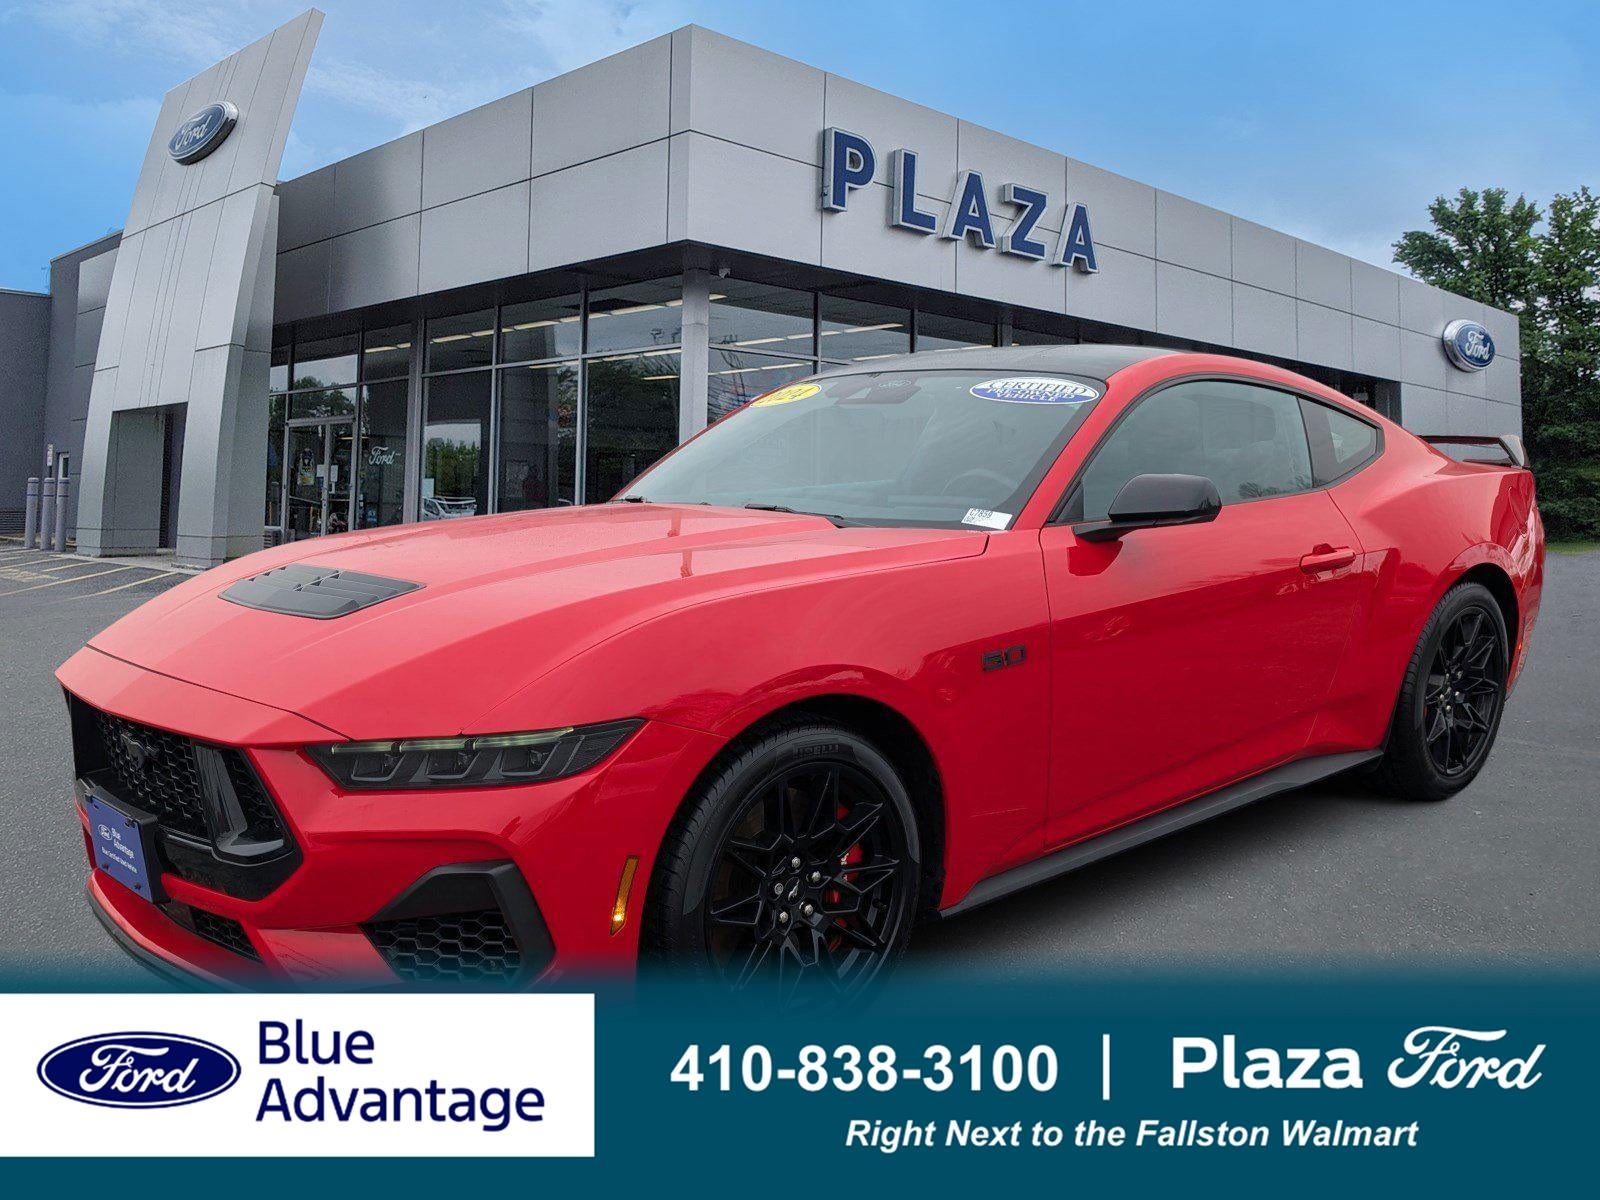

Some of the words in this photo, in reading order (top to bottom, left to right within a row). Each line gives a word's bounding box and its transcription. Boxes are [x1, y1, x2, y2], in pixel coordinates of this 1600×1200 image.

[822, 127, 1099, 274] PLAZA
[988, 381, 1088, 395] CERTIFIED
[996, 391, 1056, 402] VEHICLE
[368, 446, 395, 466] Ford
